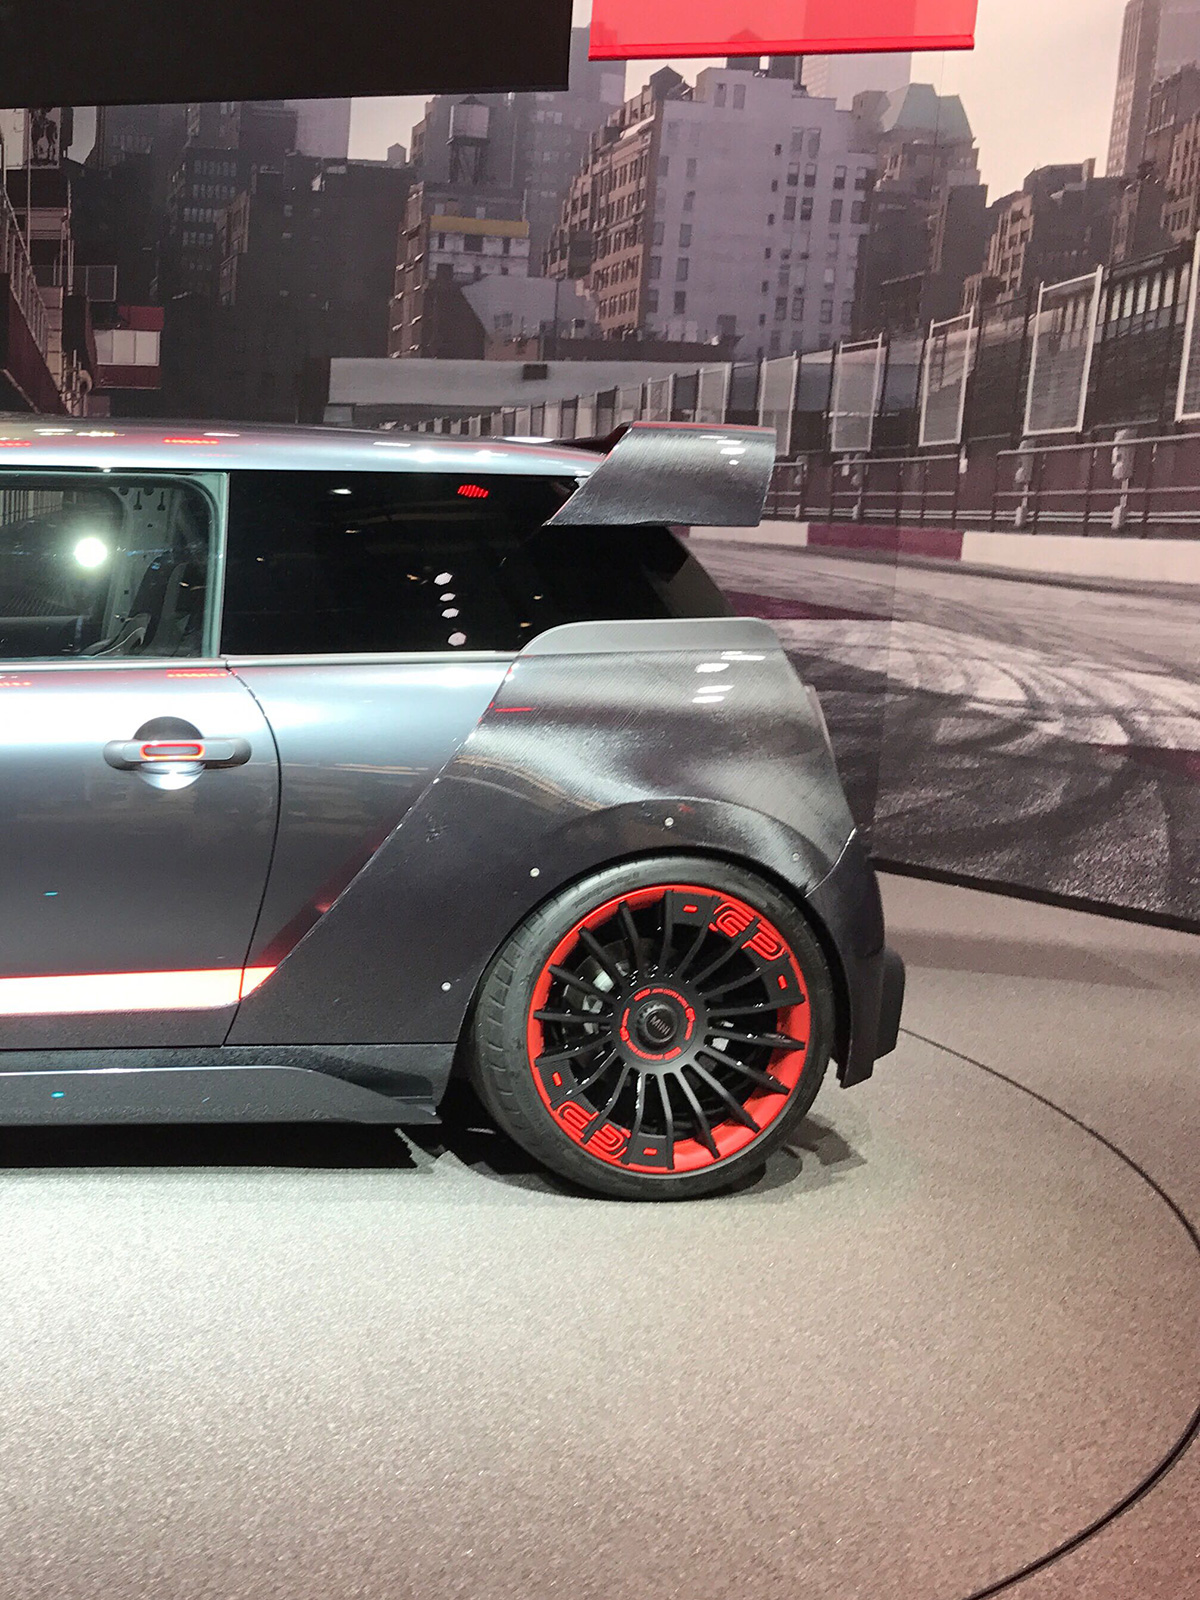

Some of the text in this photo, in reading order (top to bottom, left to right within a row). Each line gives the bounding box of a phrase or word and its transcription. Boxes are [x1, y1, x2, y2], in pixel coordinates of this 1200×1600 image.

[708, 901, 785, 961] GP
[649, 1015, 671, 1035] MINI
[557, 1101, 632, 1160] GP
